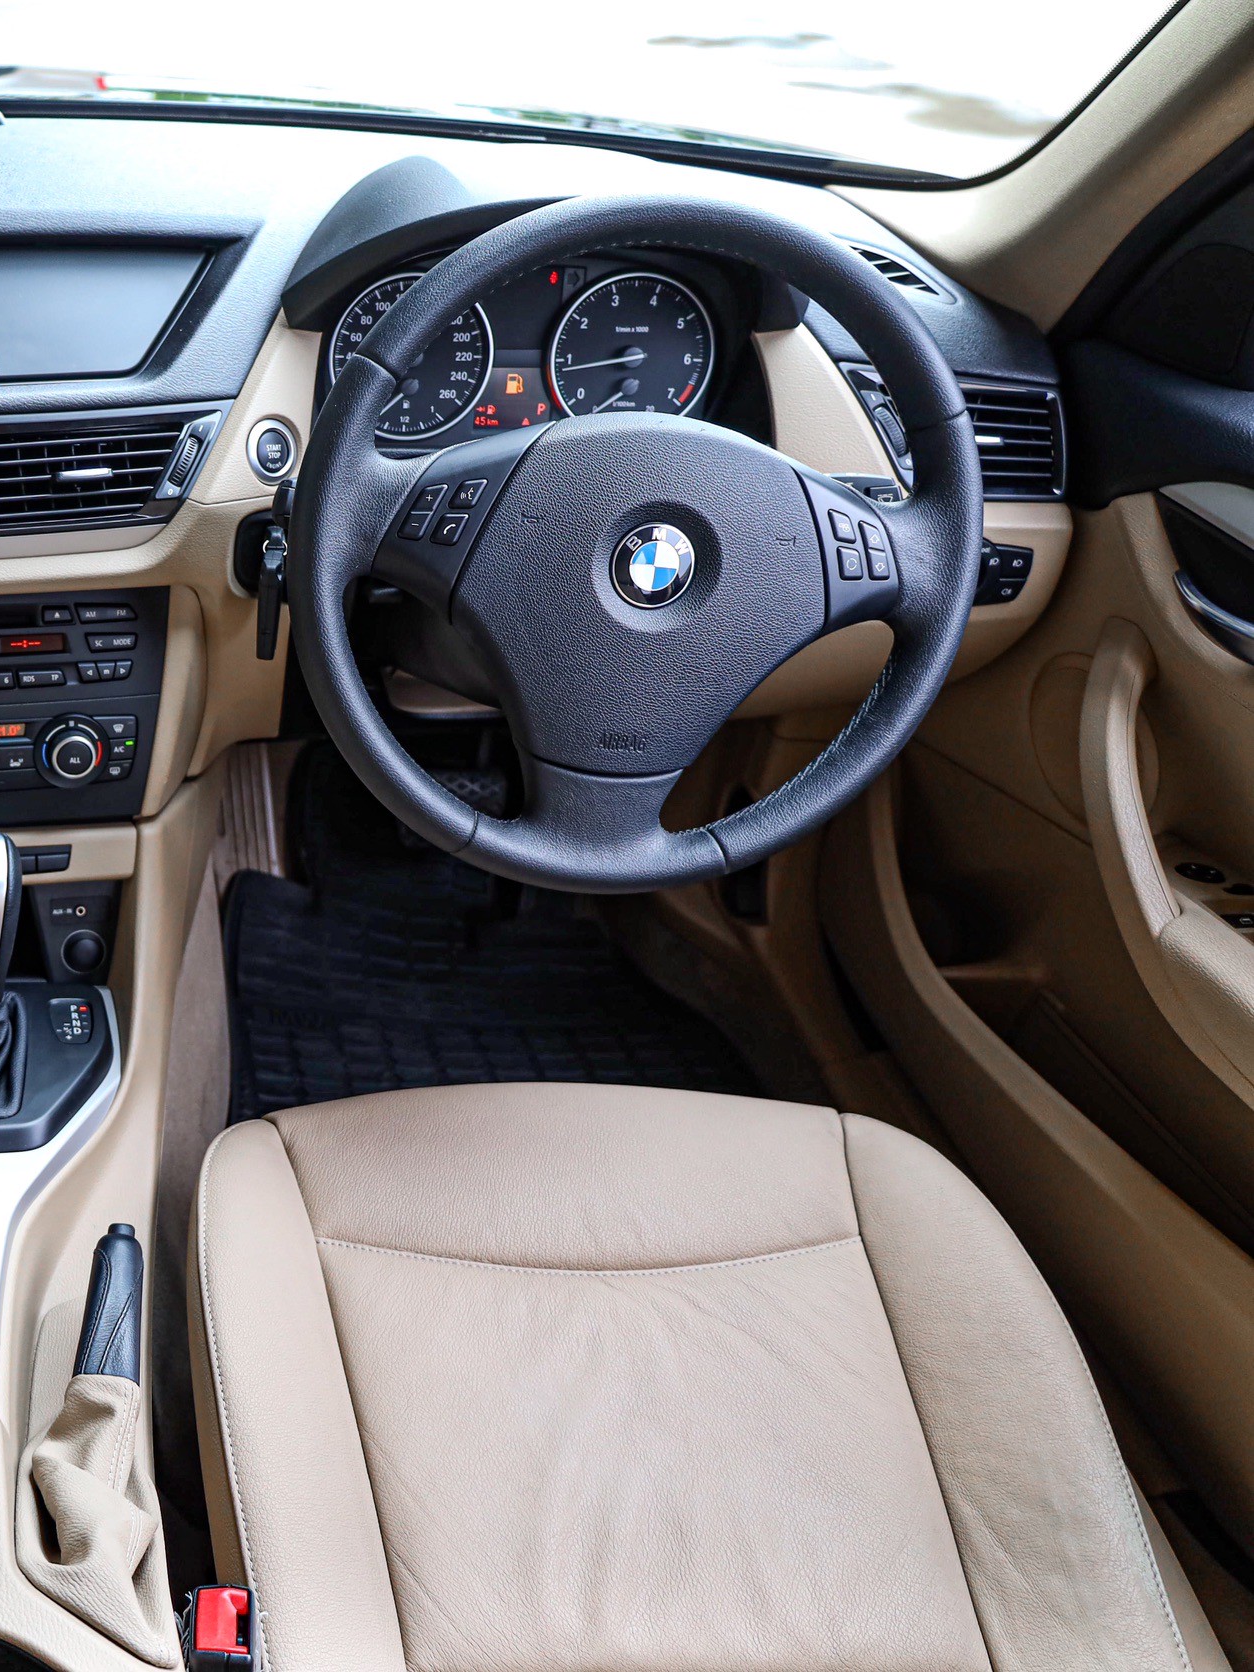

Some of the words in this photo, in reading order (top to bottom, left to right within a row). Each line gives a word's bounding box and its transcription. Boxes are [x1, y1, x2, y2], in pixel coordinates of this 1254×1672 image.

[375, 302, 391, 311] 100
[611, 295, 619, 307] 3
[649, 295, 657, 307] 4
[360, 315, 373, 325] 80
[580, 317, 589, 330] 2
[677, 317, 685, 329] 5
[350, 332, 363, 342] 60
[453, 332, 471, 343] 200
[455, 351, 473, 362] 220
[566, 353, 573, 365] 1
[683, 353, 692, 366] 6
[450, 371, 468, 382] 240
[439, 389, 457, 400] 260
[577, 387, 586, 400] 0
[667, 387, 676, 400] 7
[537, 403, 547, 415] P
[474, 416, 487, 426] 45
[487, 418, 500, 426] km
[266, 461, 282, 469] ENGINE
[626, 527, 690, 556] BMW
[94, 639, 103, 647] SC
[113, 638, 132, 646] MODE
[23, 675, 35, 683] RDS
[70, 1004, 77, 1012] P
[72, 1019, 81, 1027] N
[73, 1027, 82, 1035] D
